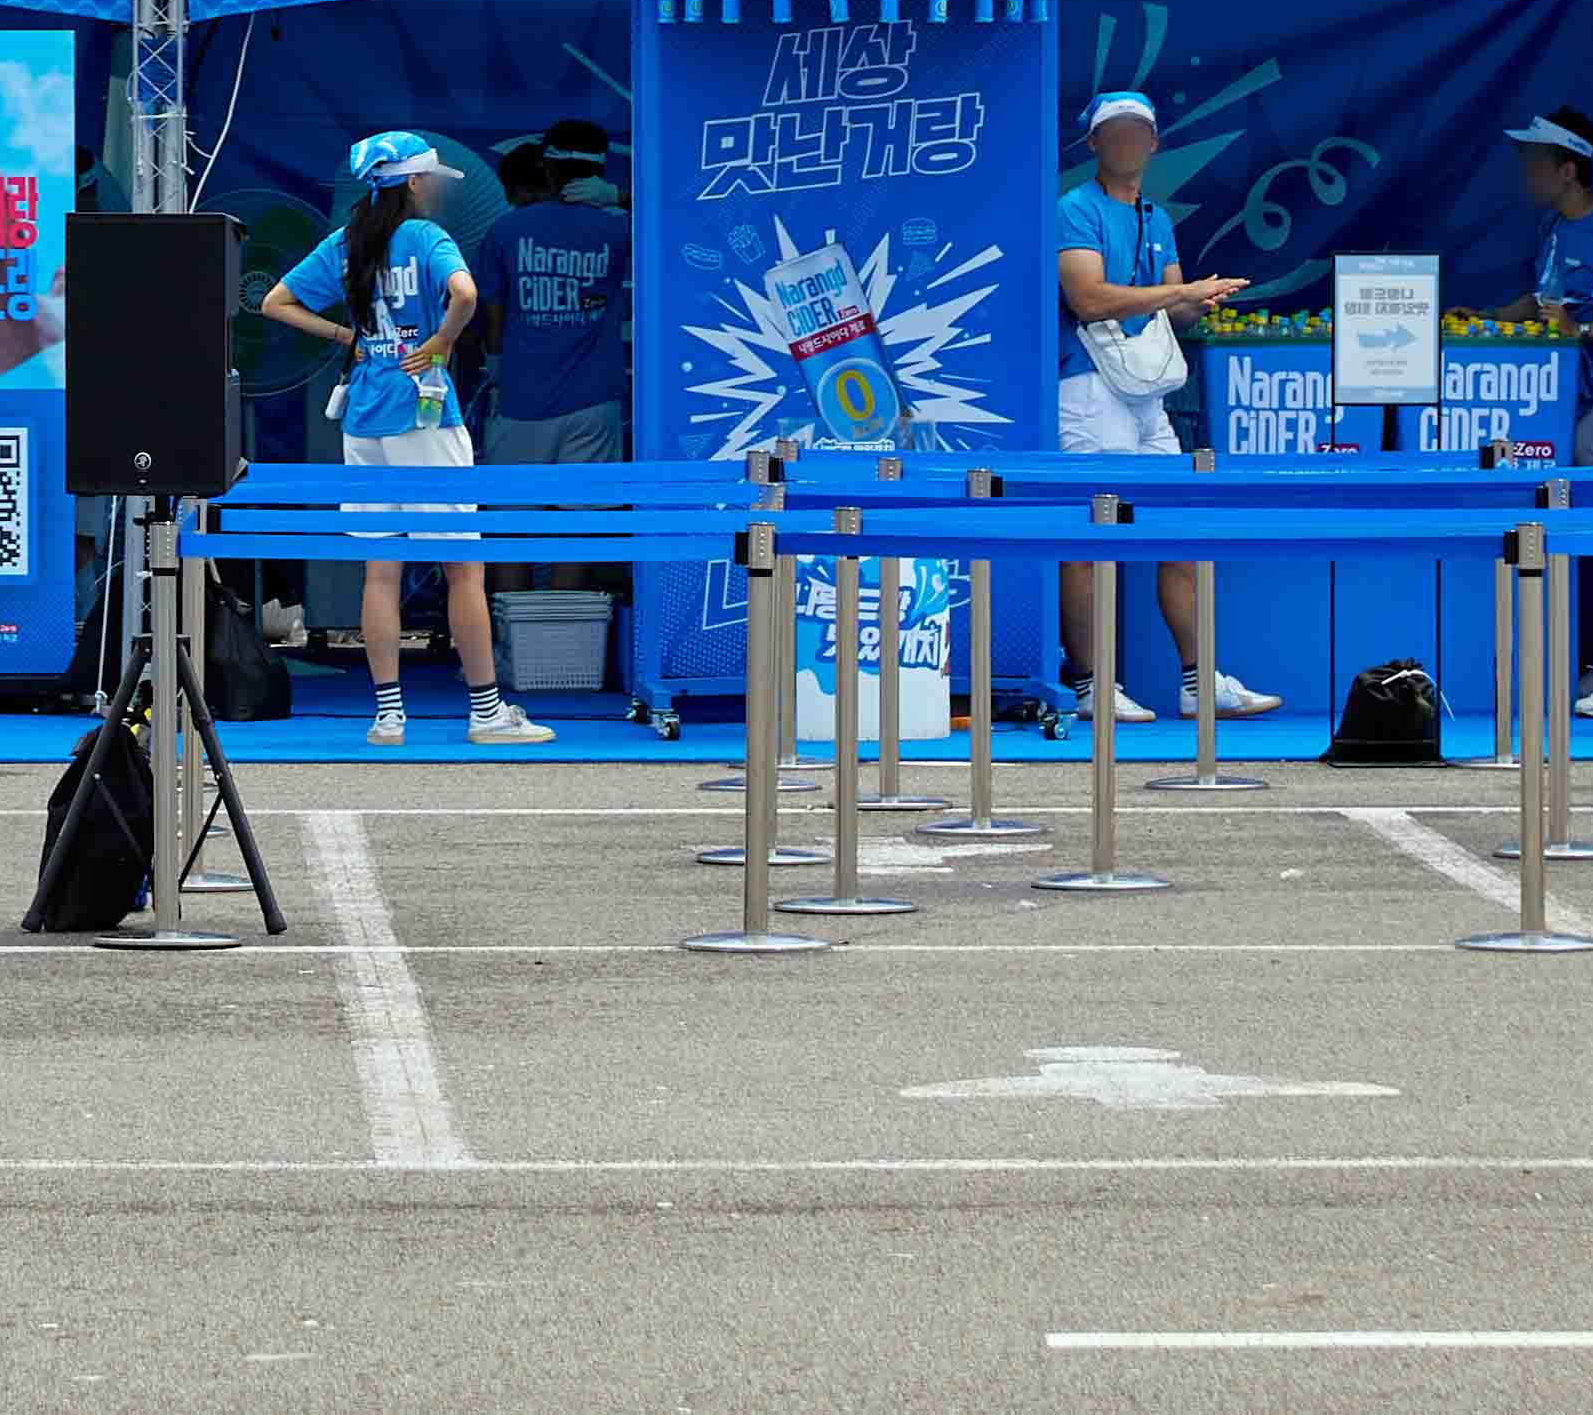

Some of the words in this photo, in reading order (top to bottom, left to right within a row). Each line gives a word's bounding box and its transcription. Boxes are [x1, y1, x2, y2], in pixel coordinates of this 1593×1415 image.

[763, 19, 916, 105] 세상
[519, 237, 609, 286] Narangd
[775, 258, 848, 308] Narangd
[837, 370, 875, 419] 0
[1515, 444, 1552, 457] Zero
